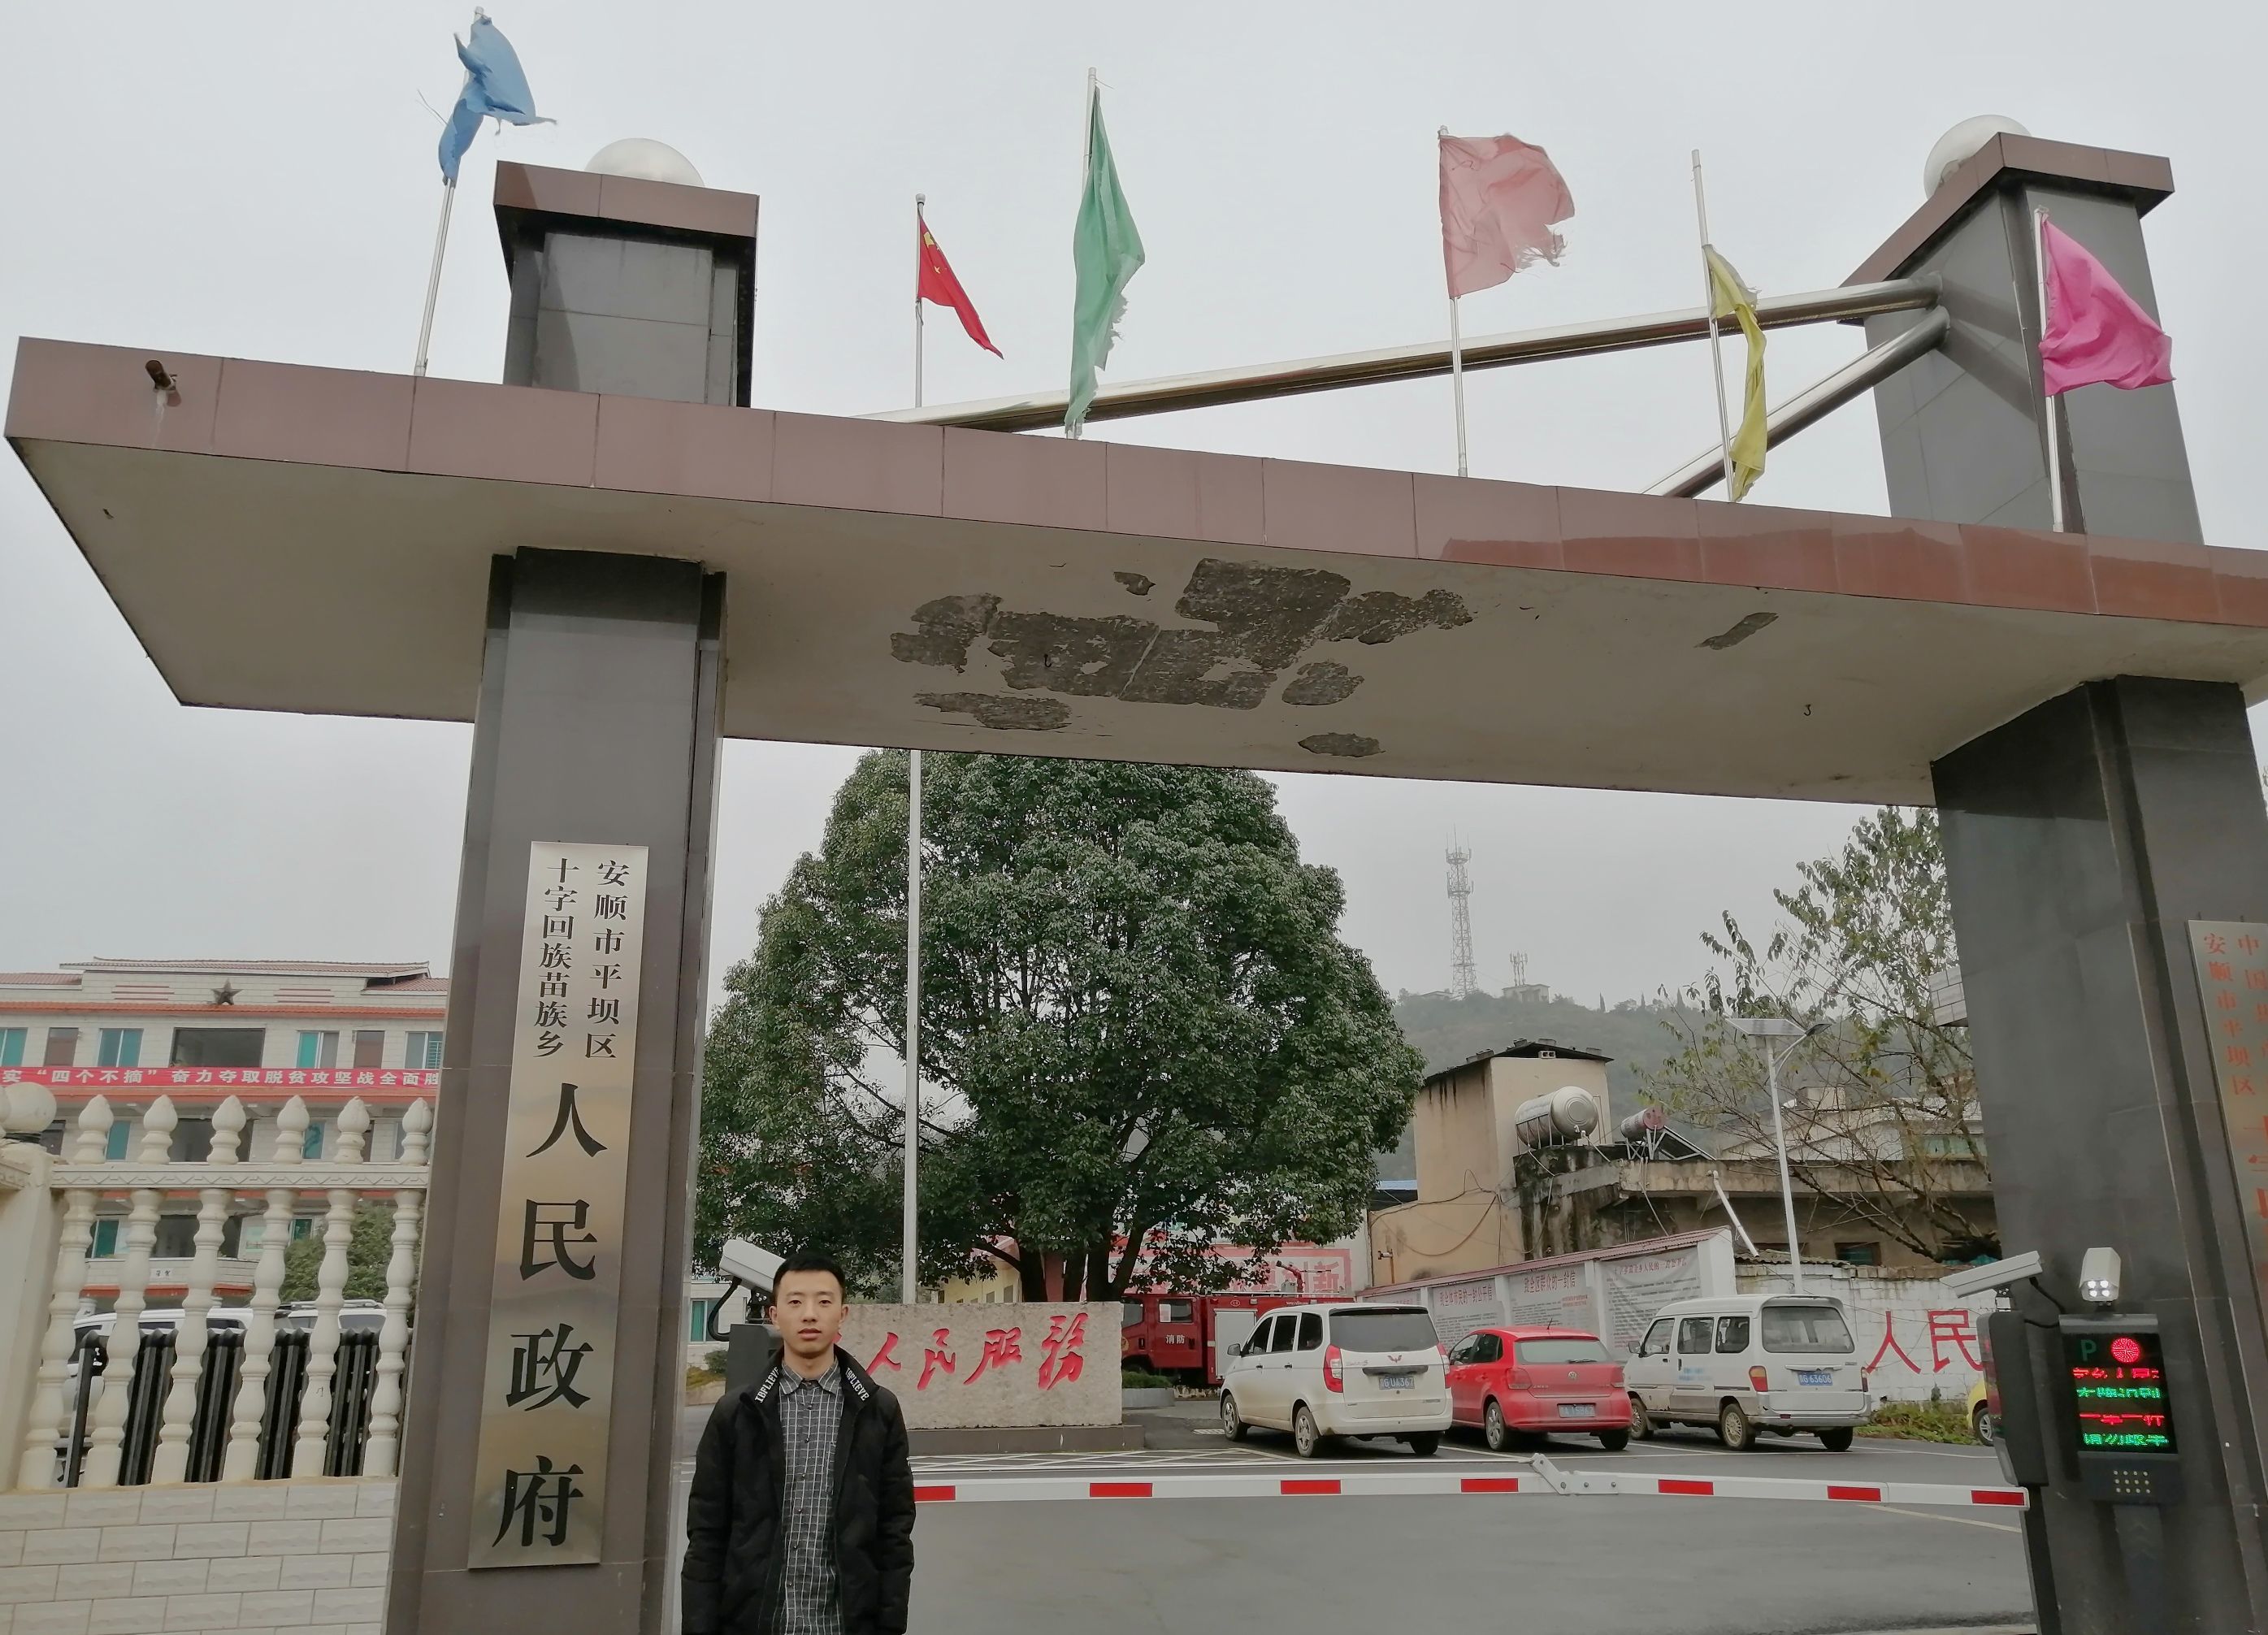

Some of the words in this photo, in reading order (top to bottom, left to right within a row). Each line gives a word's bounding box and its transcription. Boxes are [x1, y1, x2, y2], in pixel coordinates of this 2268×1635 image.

[533, 857, 579, 1059] 十字回族苗族乡
[585, 860, 630, 1059] 安顺市平坝区
[2204, 933, 2256, 1095] 安顺市平坝区
[492, 1082, 607, 1548] 人民政府
[1165, 1334, 1185, 1345] 消防
[1866, 1310, 1984, 1373] 人民
[2080, 1339, 2097, 1362] P
